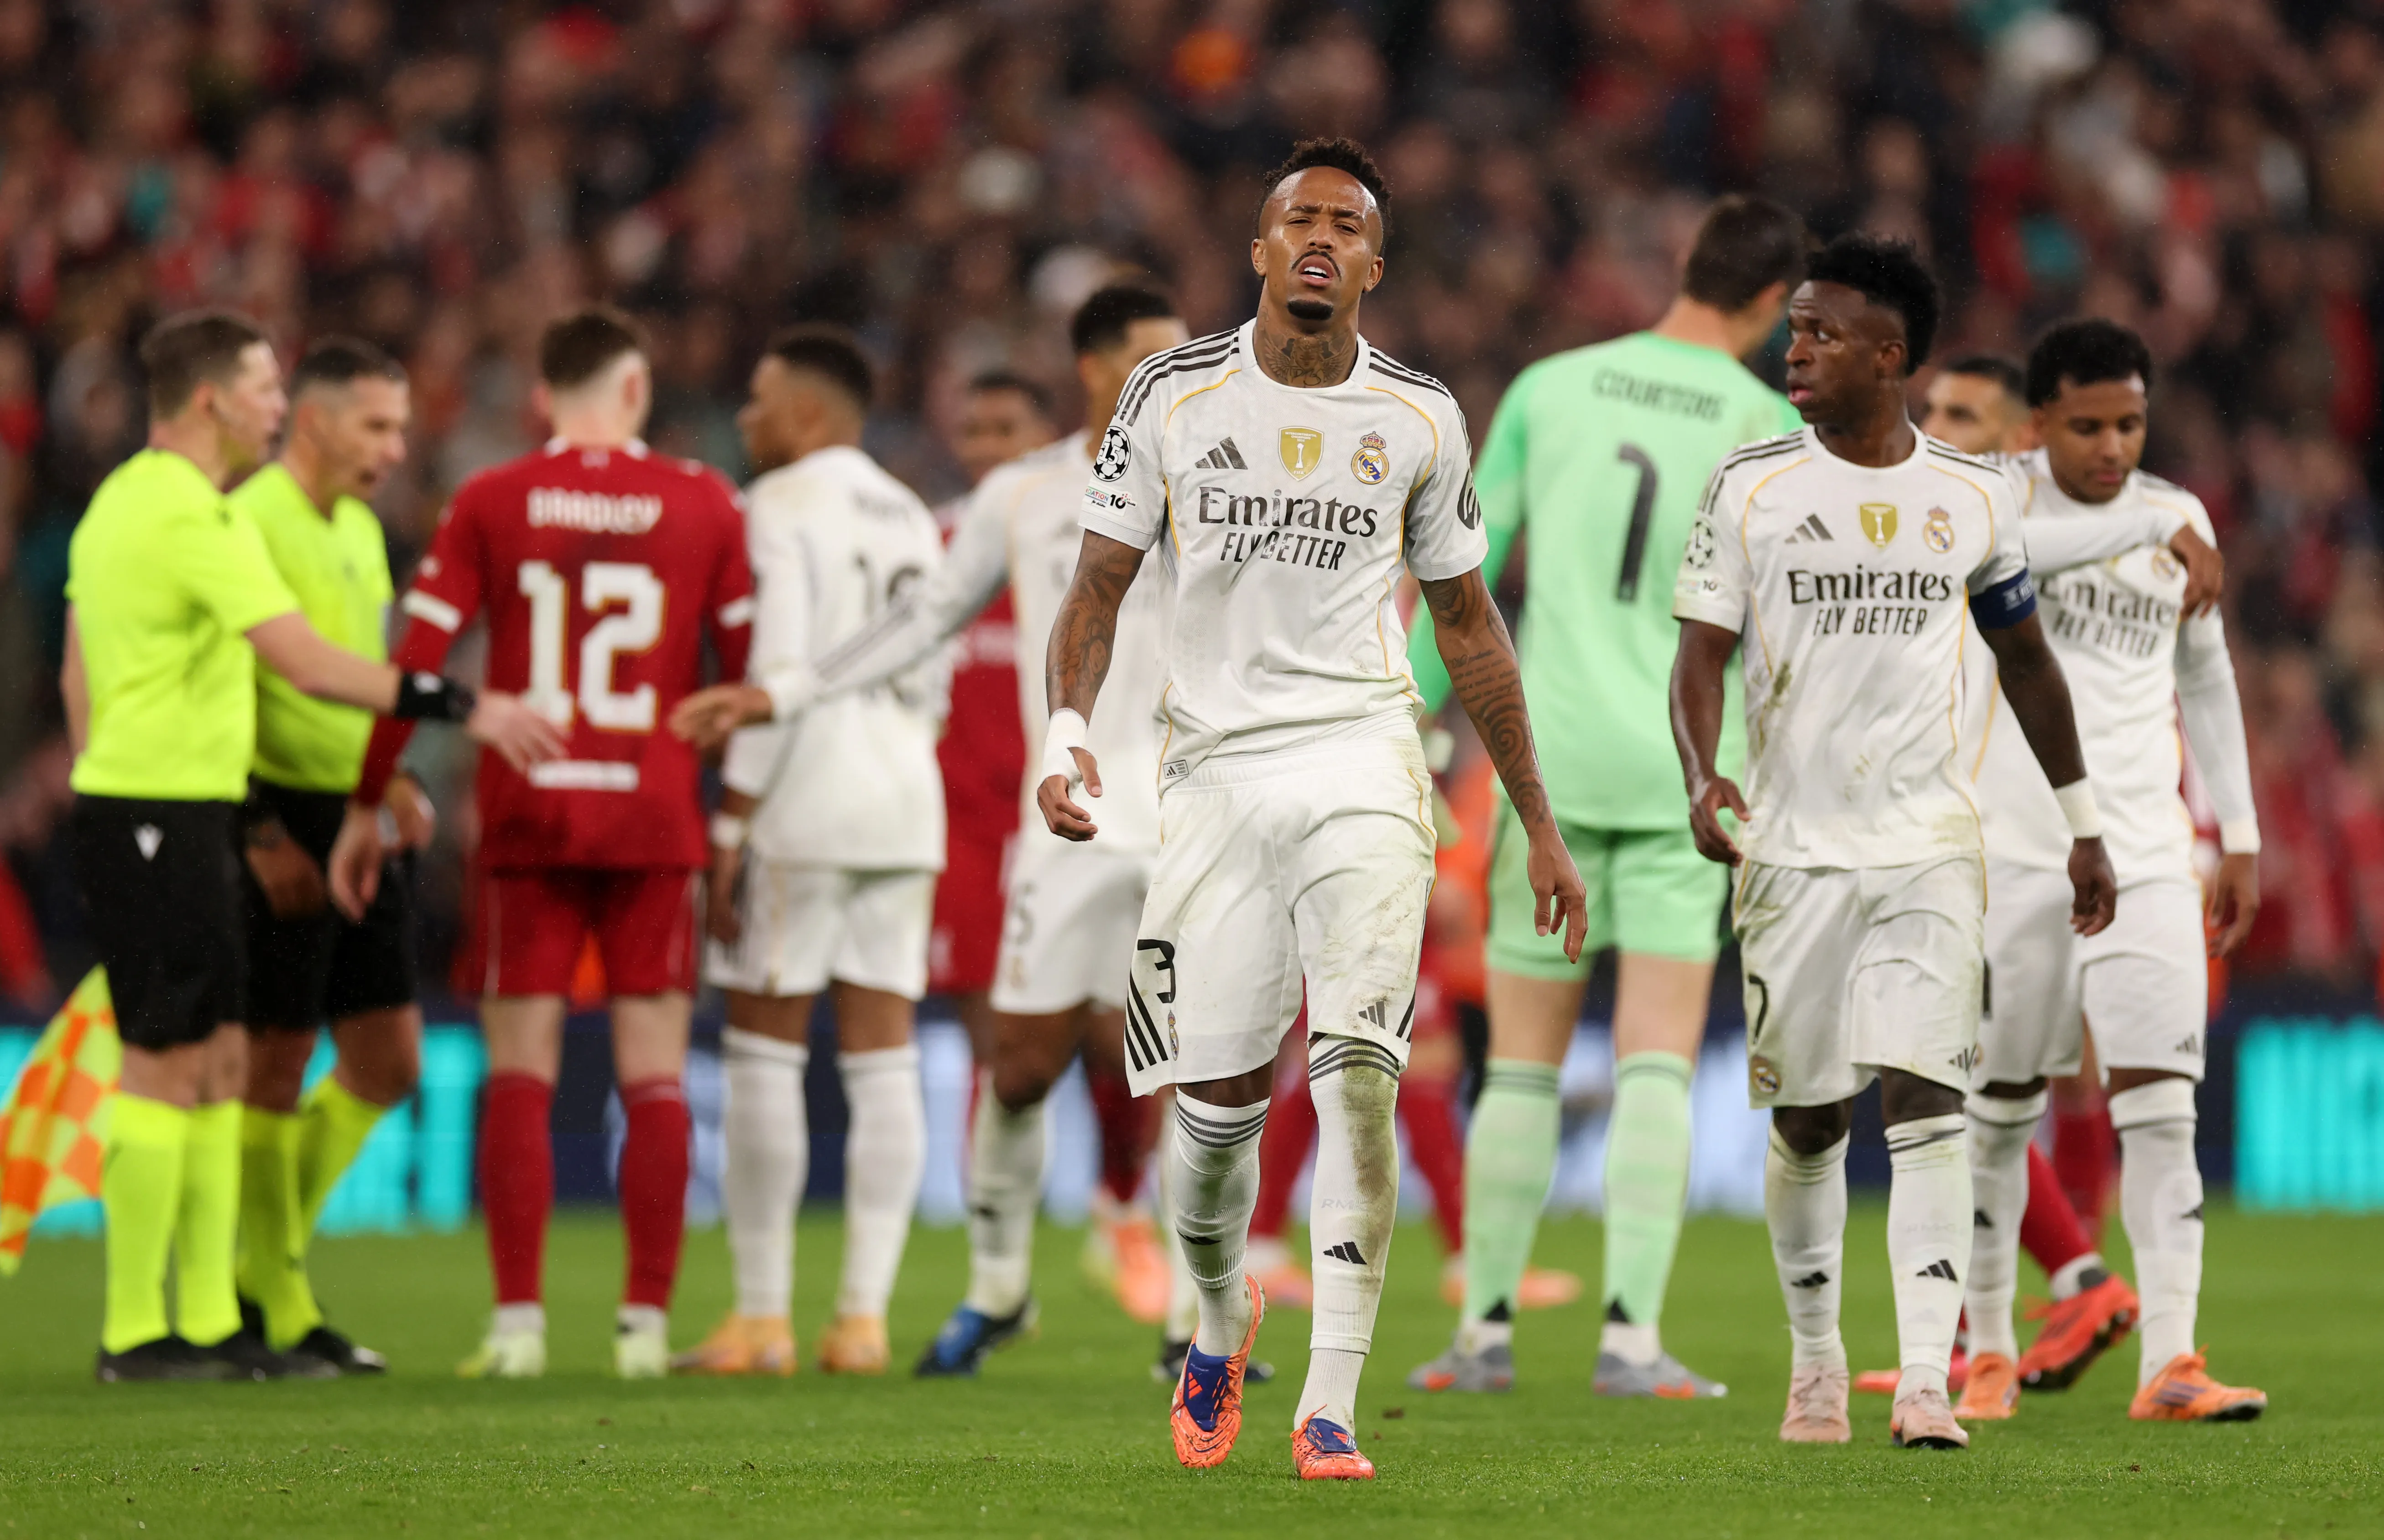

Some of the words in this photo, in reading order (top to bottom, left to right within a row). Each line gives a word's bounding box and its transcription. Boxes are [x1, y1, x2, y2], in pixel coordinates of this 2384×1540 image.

[1594, 368, 1727, 423] COURTOIS
[1099, 441, 1121, 465] 15
[527, 486, 663, 534] BRADLEY
[1110, 494, 1126, 509] 10
[1199, 486, 1377, 537] Emirates
[1617, 442, 1658, 602] 1
[1220, 532, 1262, 563] FLY
[1260, 531, 1346, 570] BETTER
[1787, 564, 1953, 605] Emirates
[1813, 607, 1846, 636] FLY
[1853, 607, 1928, 636] BETTER
[518, 560, 666, 733] 12
[1137, 939, 1176, 1003] 3
[1749, 973, 1768, 1044] 7
